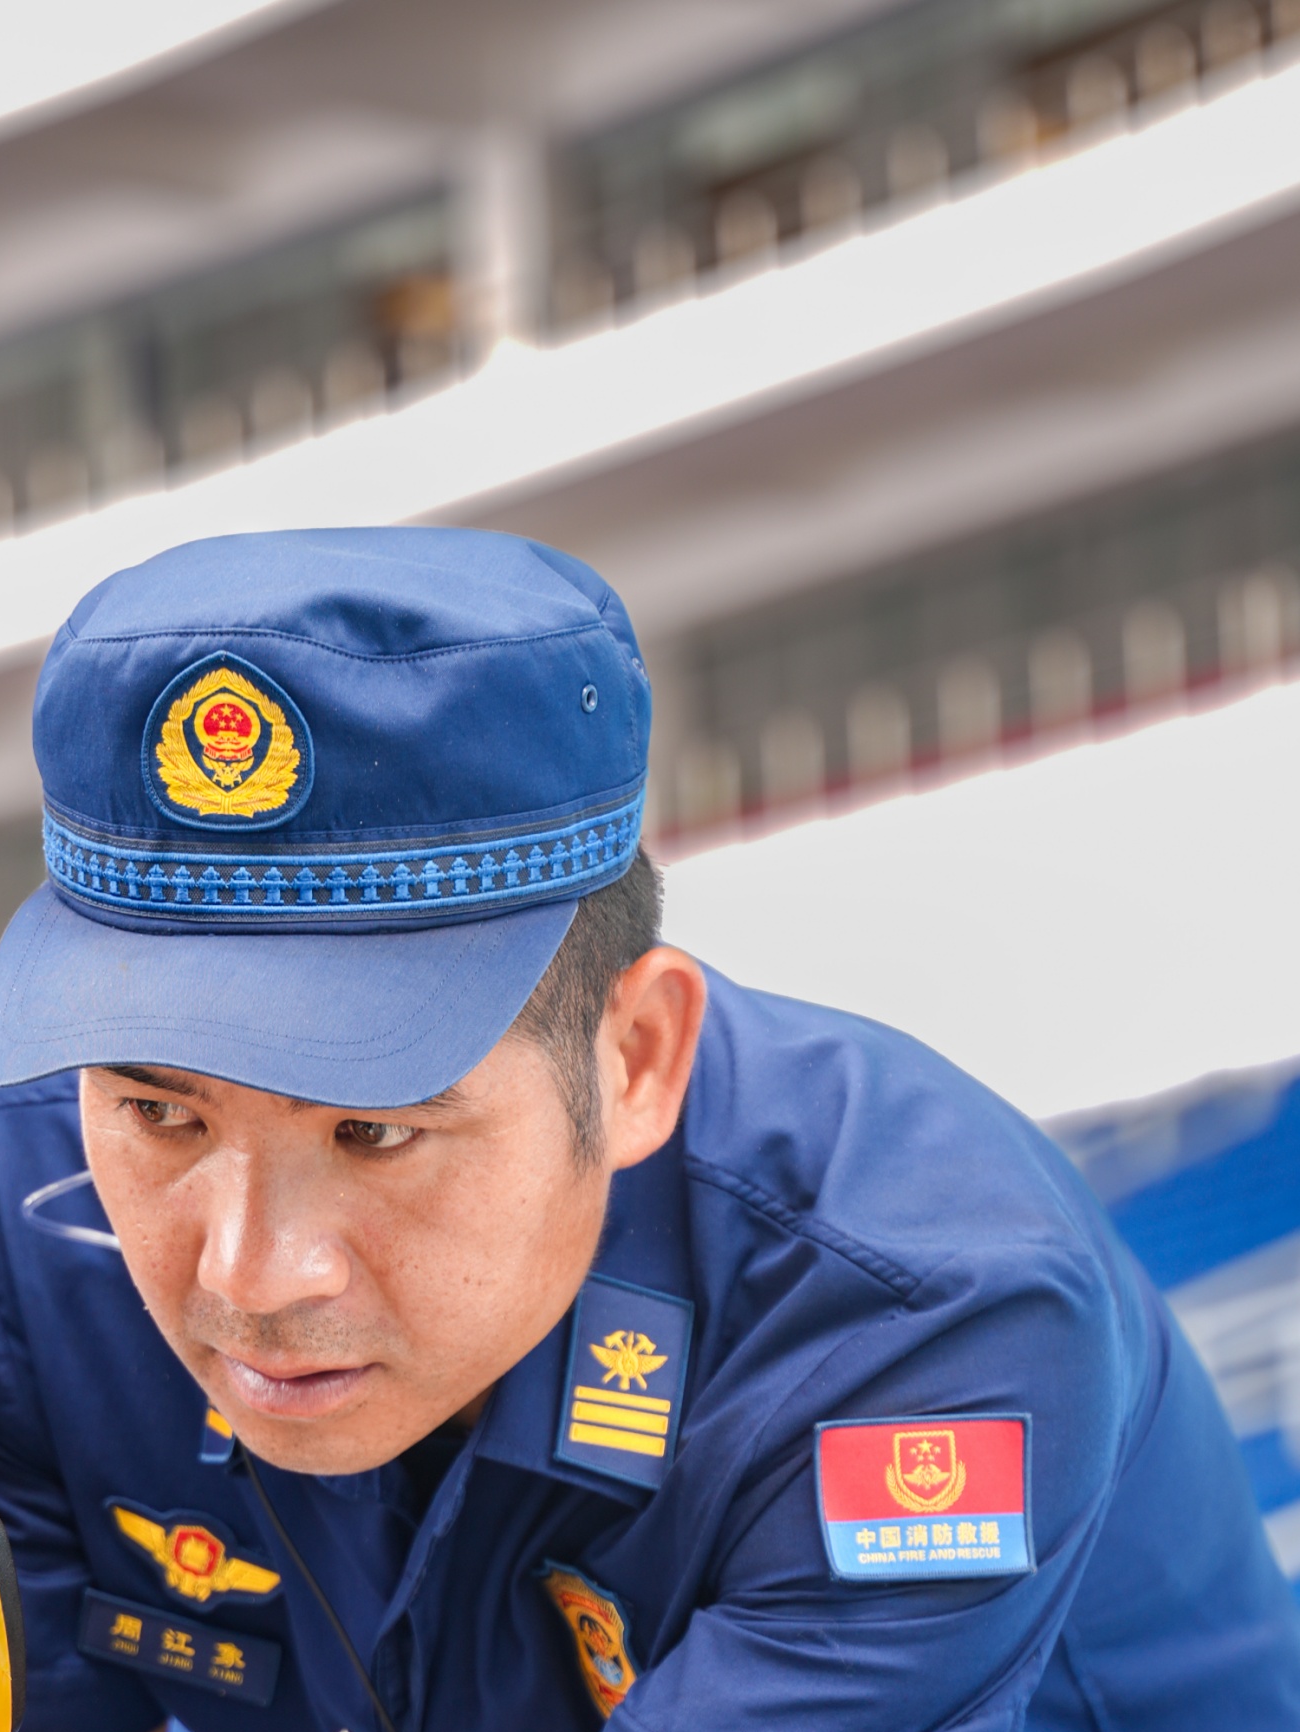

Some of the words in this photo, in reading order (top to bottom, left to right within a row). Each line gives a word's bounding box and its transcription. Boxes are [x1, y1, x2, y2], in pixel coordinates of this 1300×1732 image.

[855, 1521, 1001, 1550] 中国消防救援
[858, 1551, 897, 1564] CHINA
[898, 1549, 926, 1562] FIRE
[929, 1547, 956, 1561] AND
[957, 1546, 1001, 1559] RESCUE
